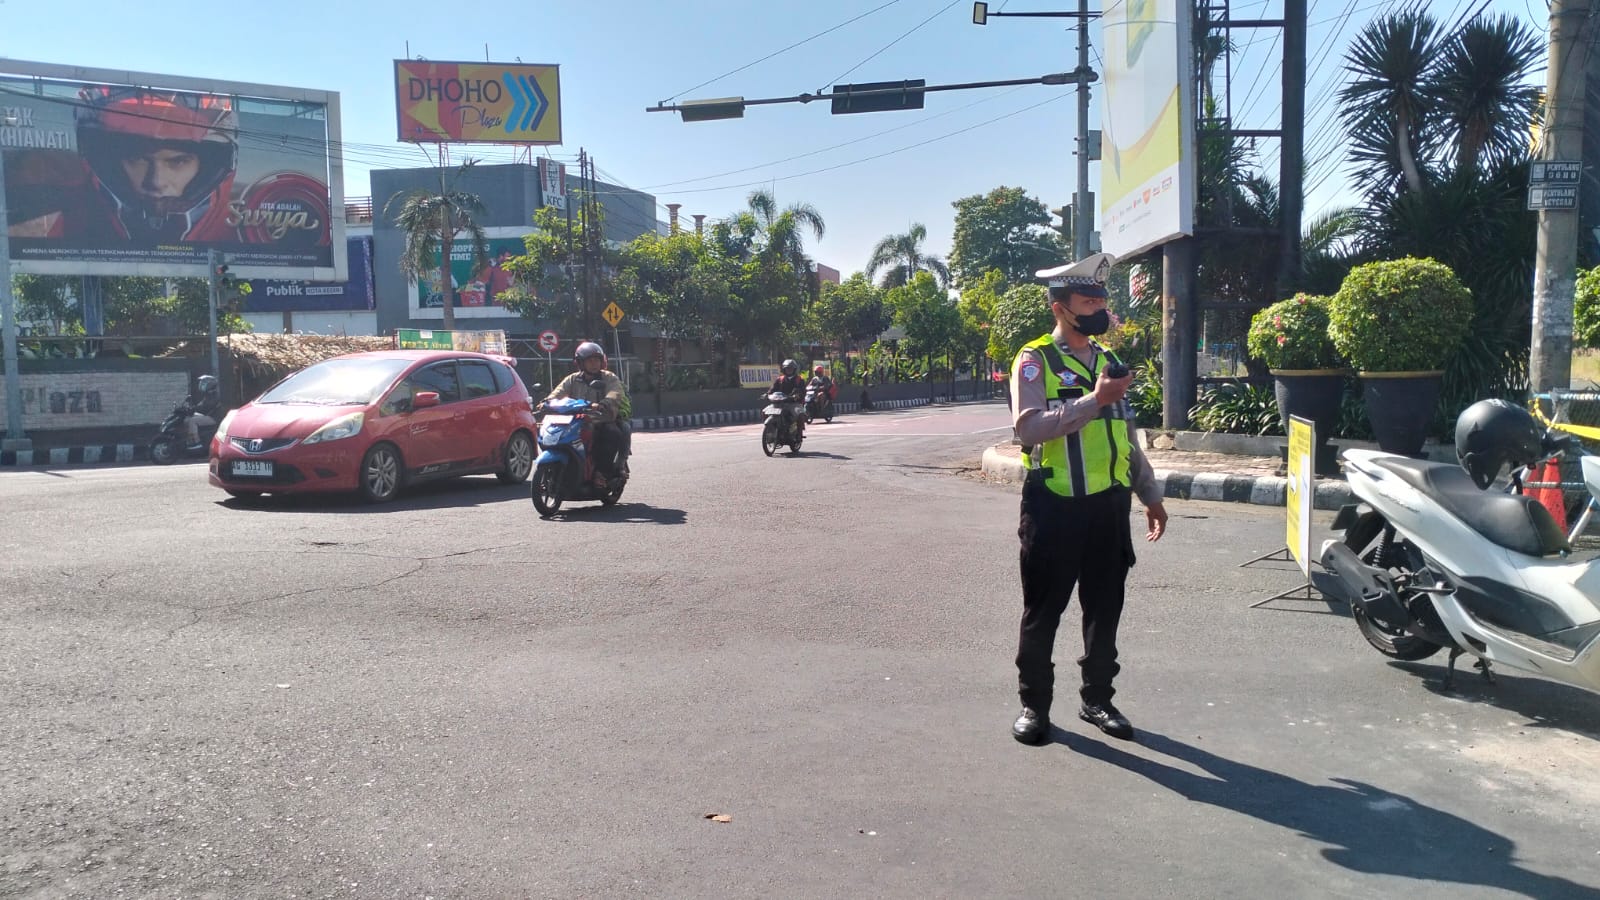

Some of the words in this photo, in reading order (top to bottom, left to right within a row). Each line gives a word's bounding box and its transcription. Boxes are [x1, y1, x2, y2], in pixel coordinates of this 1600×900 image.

[408, 77, 502, 103] DHOHO
[451, 105, 502, 129] Plaza
[546, 195, 563, 208] KFC
[226, 200, 319, 239] Surya
[266, 285, 303, 296] Publik
